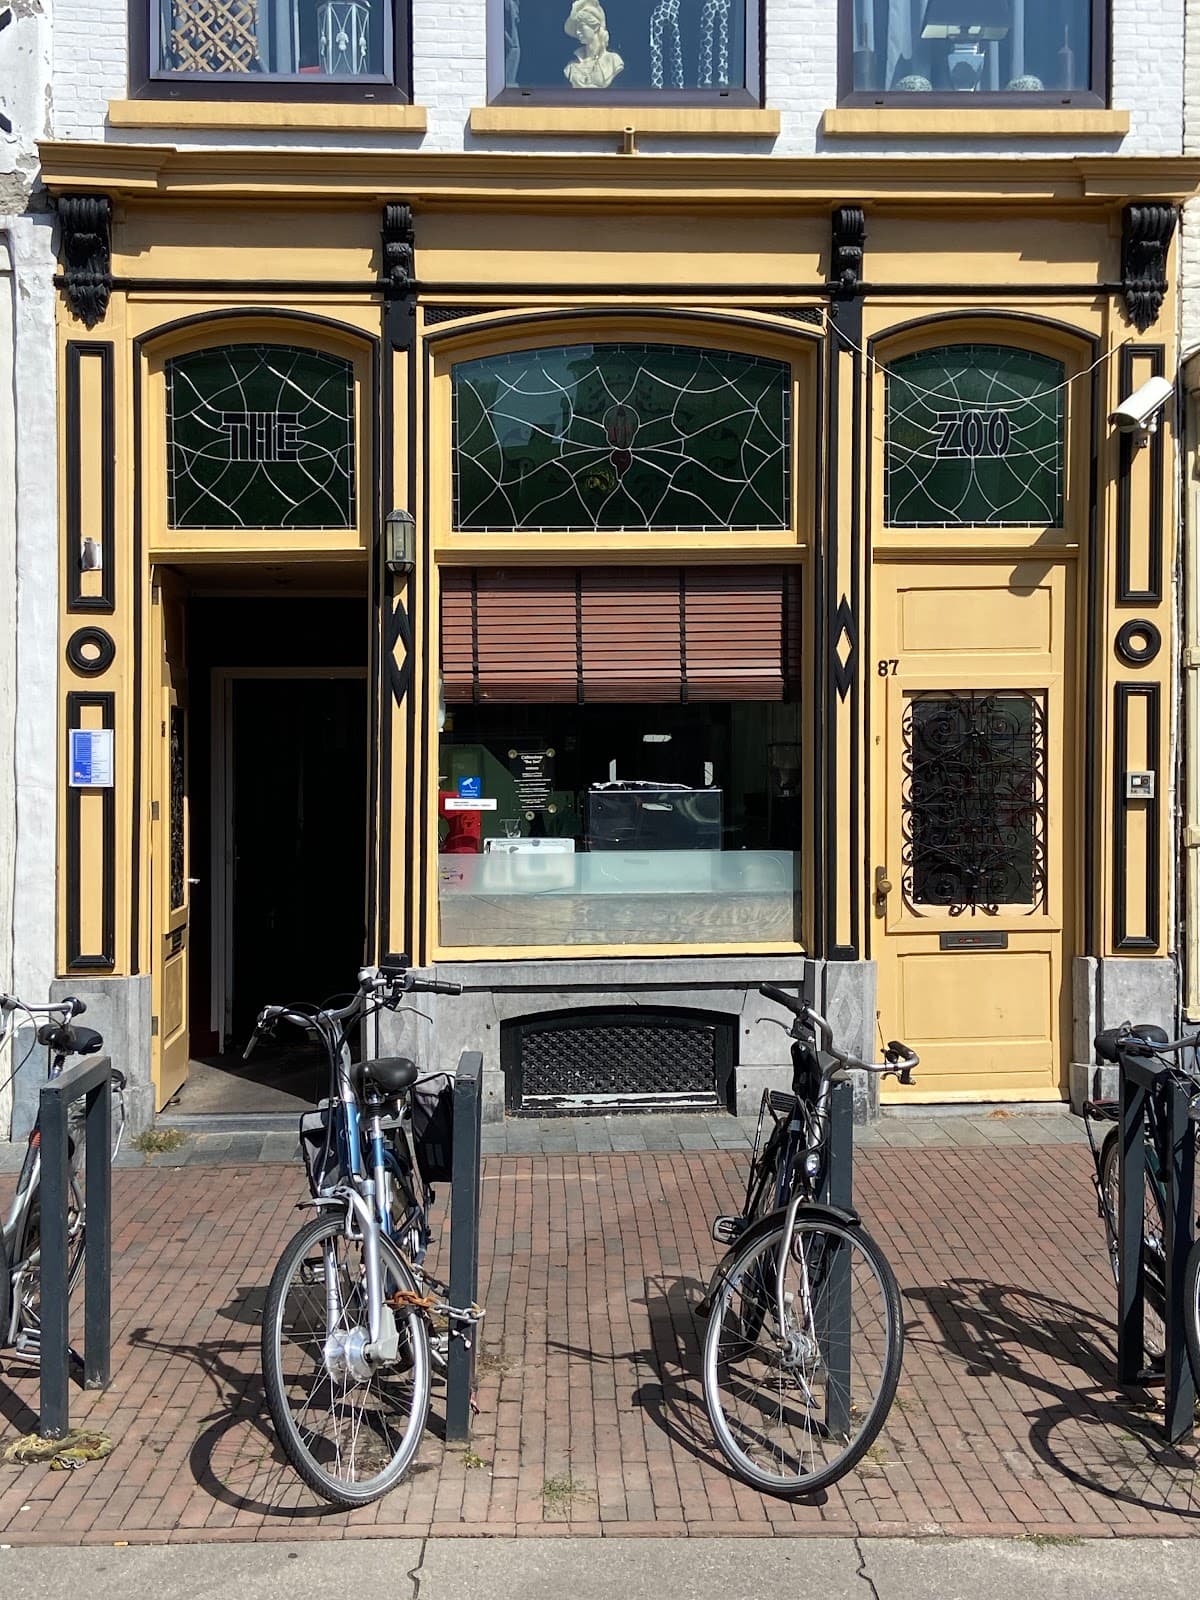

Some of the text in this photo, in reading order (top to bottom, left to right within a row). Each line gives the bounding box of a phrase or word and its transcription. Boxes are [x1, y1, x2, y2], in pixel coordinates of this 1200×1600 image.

[222, 412, 299, 461] THE
[936, 410, 1010, 458] ZOO
[878, 659, 900, 677] 87
